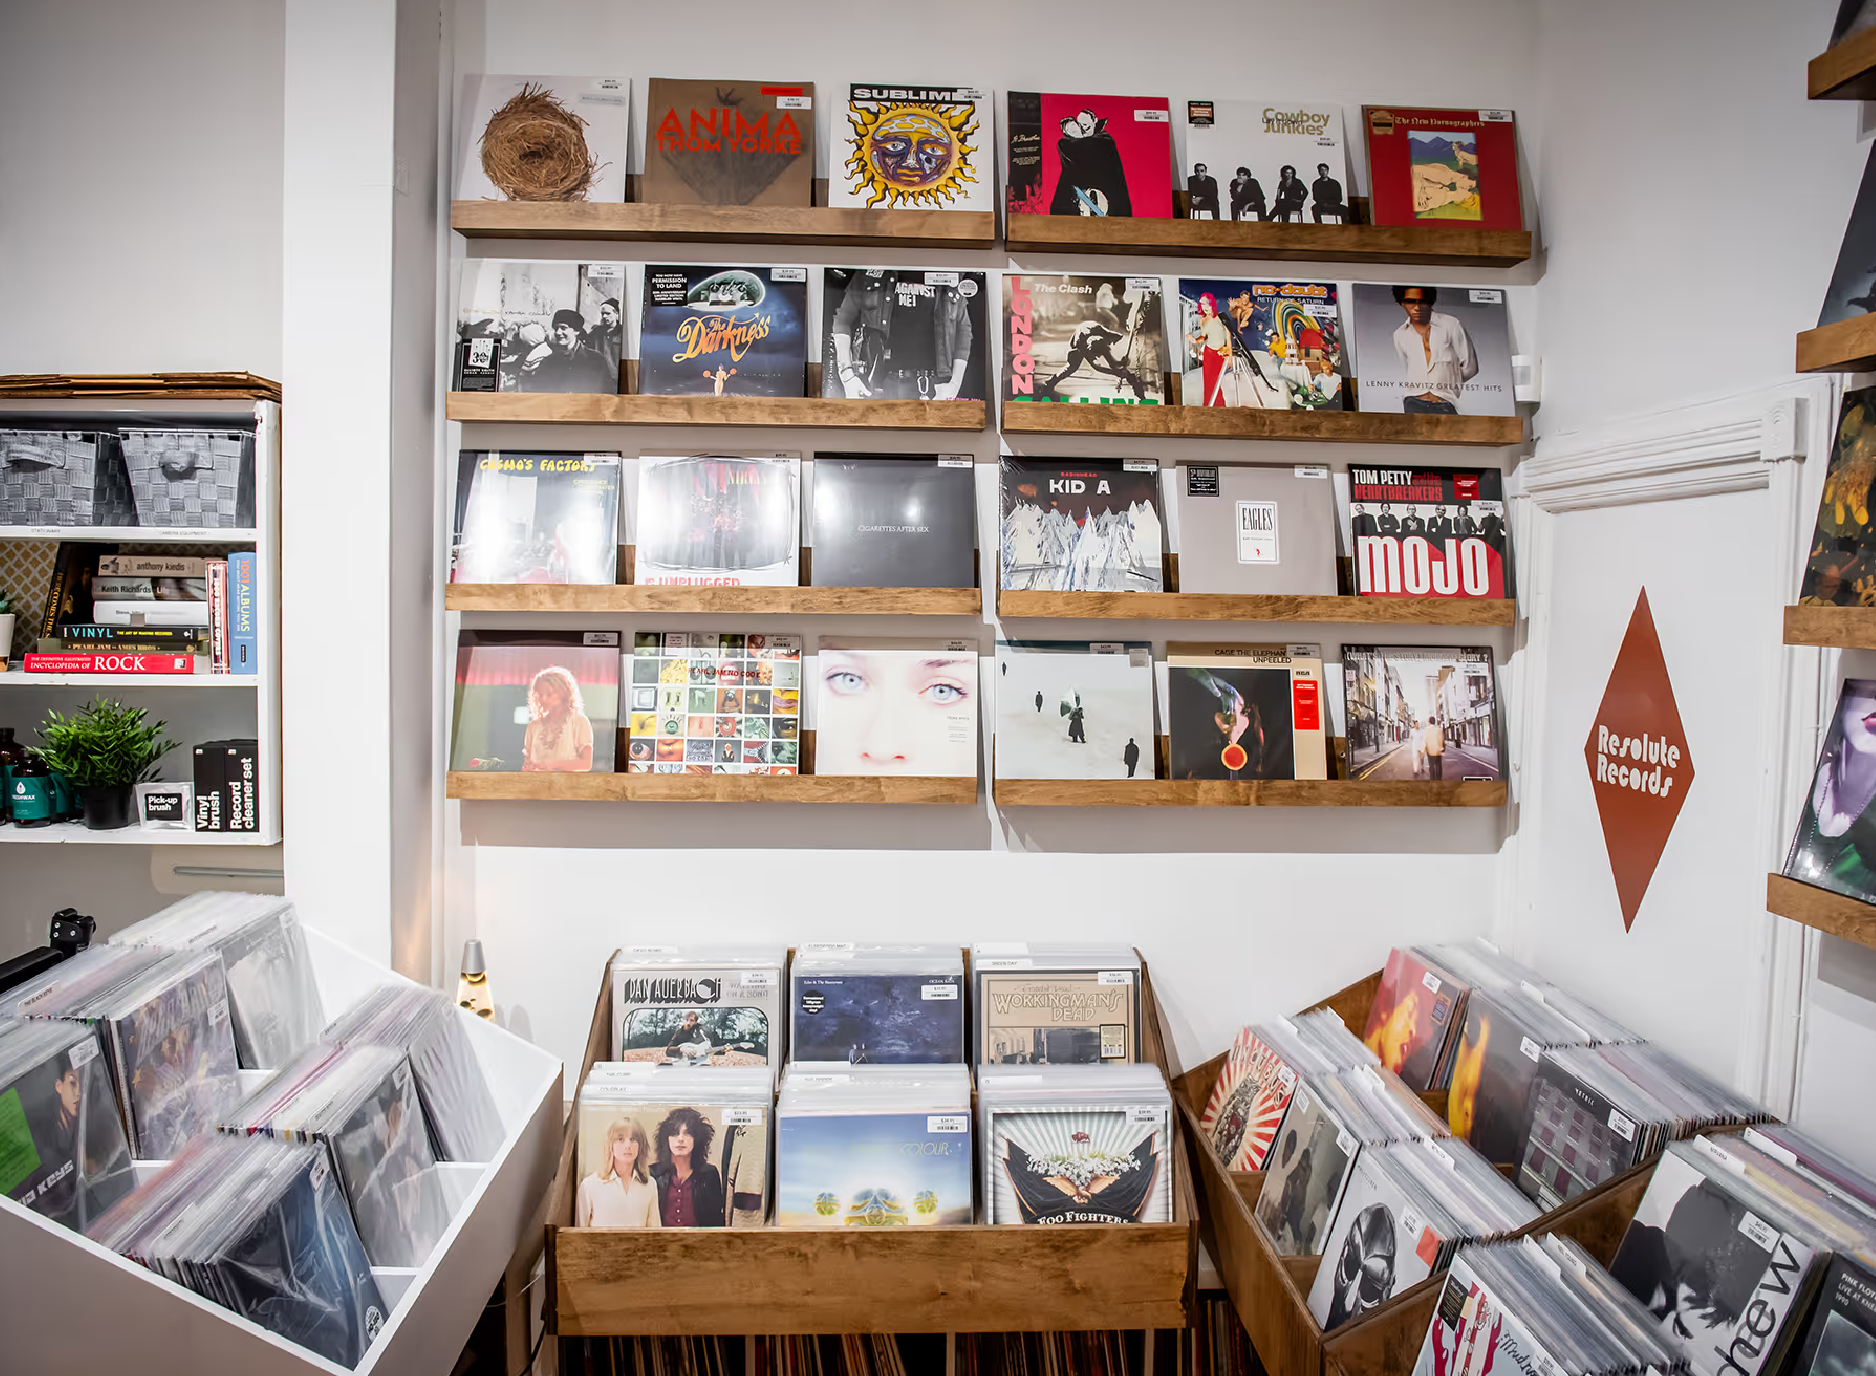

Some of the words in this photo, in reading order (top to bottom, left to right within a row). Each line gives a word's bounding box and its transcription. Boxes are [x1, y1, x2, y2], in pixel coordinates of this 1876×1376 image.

[655, 108, 802, 139] ANIMA
[1263, 108, 1330, 127] Cowboy
[1264, 123, 1324, 136] Junkies
[655, 136, 721, 152] THOM
[729, 137, 802, 155] YORKE
[895, 283, 936, 298] AGAINST
[1034, 284, 1057, 293] The
[1058, 285, 1093, 294] Clash
[1280, 283, 1328, 298] doubt
[898, 294, 917, 307] ME!
[672, 312, 771, 363] Darkness
[1011, 277, 1035, 395] LONDON
[1399, 382, 1434, 390] KRAVITZ
[1436, 382, 1480, 391] GREATEST
[479, 458, 533, 471] COSMO'S
[1352, 469, 1379, 485] TOM
[1380, 470, 1412, 486] PETTY
[1049, 479, 1086, 494] KID
[1097, 480, 1111, 494] A
[1354, 485, 1443, 501] HEARTBREAKERS
[1242, 507, 1273, 531] EAGLES
[136, 562, 164, 572] anthony
[240, 559, 250, 584] 1001
[1357, 535, 1490, 596] MOJO
[100, 585, 119, 593] Keith
[120, 585, 152, 593] Richards
[240, 584, 251, 632] ALBUMS
[72, 627, 113, 637] VINYL
[30, 662, 79, 670] ENCYCLOPEDIA
[81, 662, 91, 670] OF
[94, 656, 146, 671] ROCK
[1253, 656, 1292, 664] UNPEELED
[1598, 725, 1680, 768] Resolute
[241, 757, 253, 785] set
[1597, 752, 1673, 798] Records
[148, 795, 178, 805] Pick-up
[148, 803, 172, 812] brush
[229, 782, 242, 829] Record
[242, 786, 253, 829] cleaner
[197, 795, 208, 829] Vinyl
[208, 791, 220, 829] brush
[624, 978, 649, 1004] DAN
[650, 977, 722, 1004] AUERBACH
[992, 988, 1124, 1014] WORKINGMAN'S
[1051, 1008, 1096, 1022] DEAD
[1038, 1214, 1064, 1224] FOO
[1065, 1211, 1129, 1224] FIGHTERS
[1841, 1272, 1859, 1288] PINK
[1838, 1282, 1853, 1297] LIVE
[1835, 1291, 1849, 1306] 1990
